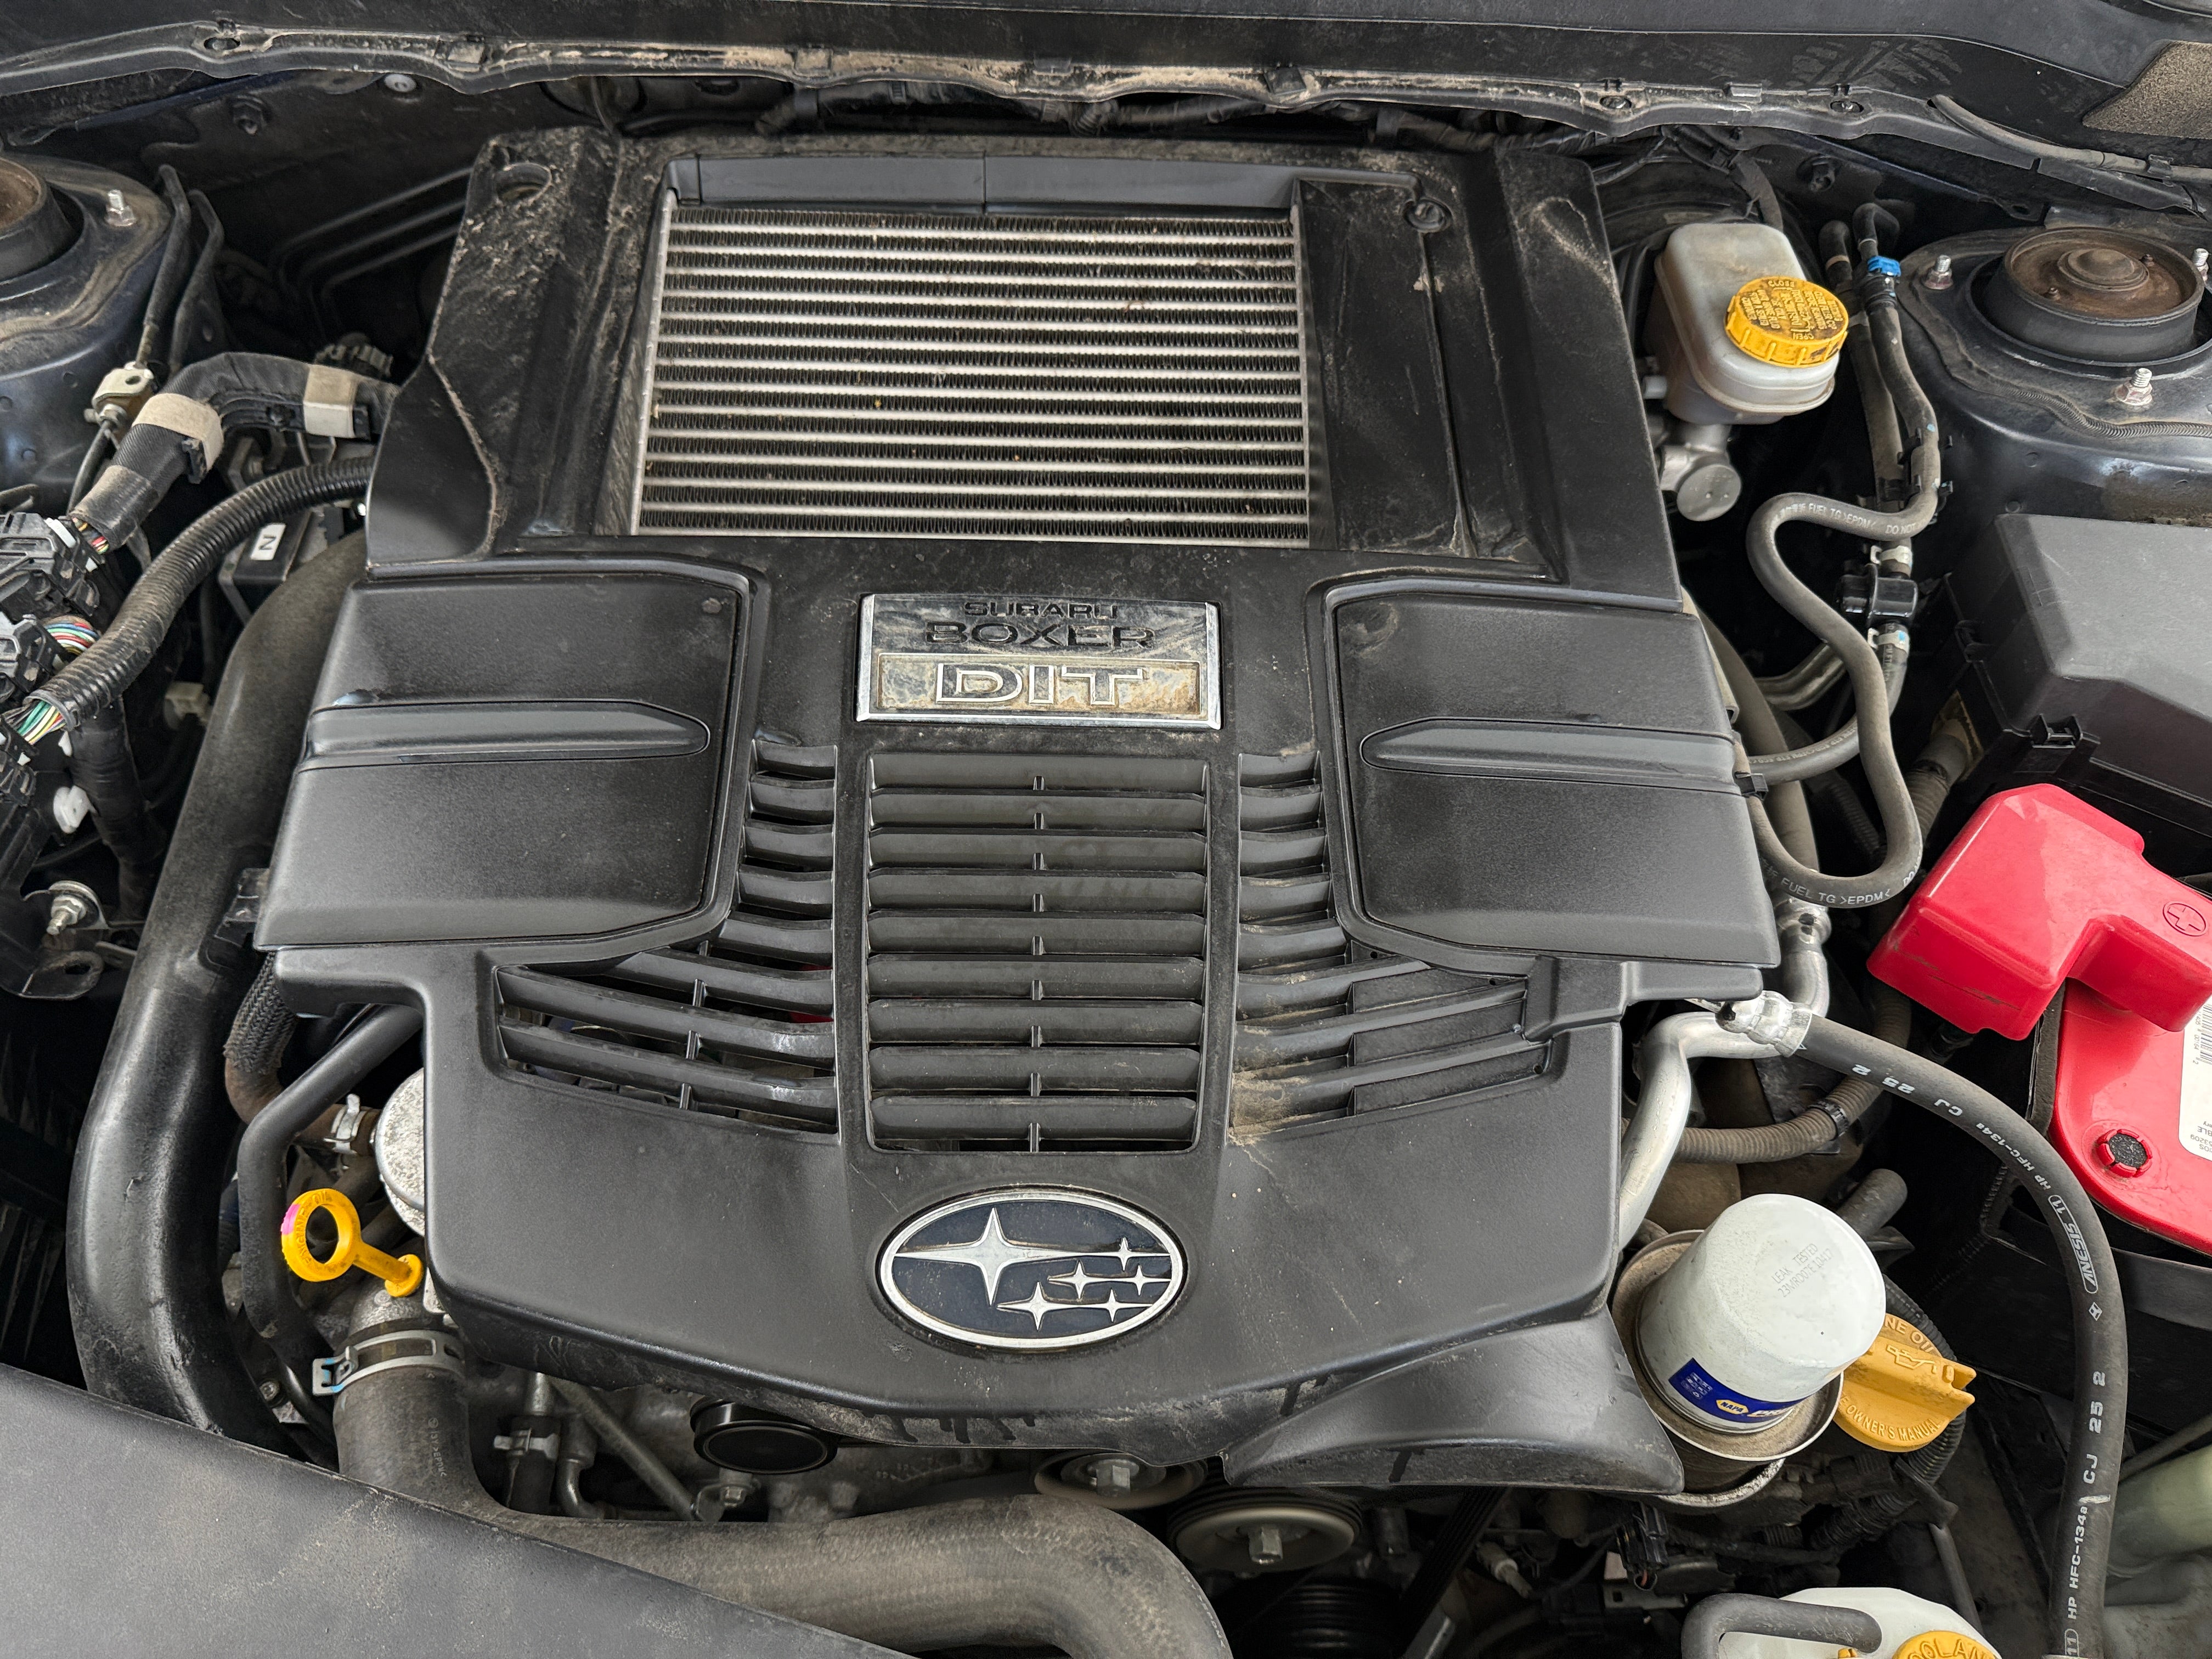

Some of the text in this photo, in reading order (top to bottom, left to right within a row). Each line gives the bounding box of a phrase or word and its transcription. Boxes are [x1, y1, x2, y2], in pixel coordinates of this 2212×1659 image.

[1884, 524, 1898, 534] DO
[1900, 523, 1916, 534] NOT
[964, 601, 1118, 619] SUBARU
[926, 622, 1155, 649] BOXER
[936, 662, 1147, 706] DIT
[1781, 878, 1812, 898] FUEL
[1818, 892, 1836, 904] TG
[1852, 1063, 1871, 1076] 2
[1881, 1076, 1915, 1094] 25
[1934, 1098, 1963, 1117] CJ
[1976, 1122, 2035, 1172] HFC-134a
[2035, 1173, 2051, 1191] HP
[1771, 1243, 1818, 1284] LEAK TESTED
[2092, 1370, 2106, 1387] 2
[1720, 1402, 1743, 1413] NAPA
[2089, 1401, 2103, 1434] 25
[1846, 1404, 1895, 1440] OWNER'S
[1897, 1418, 1941, 1441] MANUAL
[2083, 1453, 2098, 1485] CJ
[2067, 1596, 2078, 1621] HP
